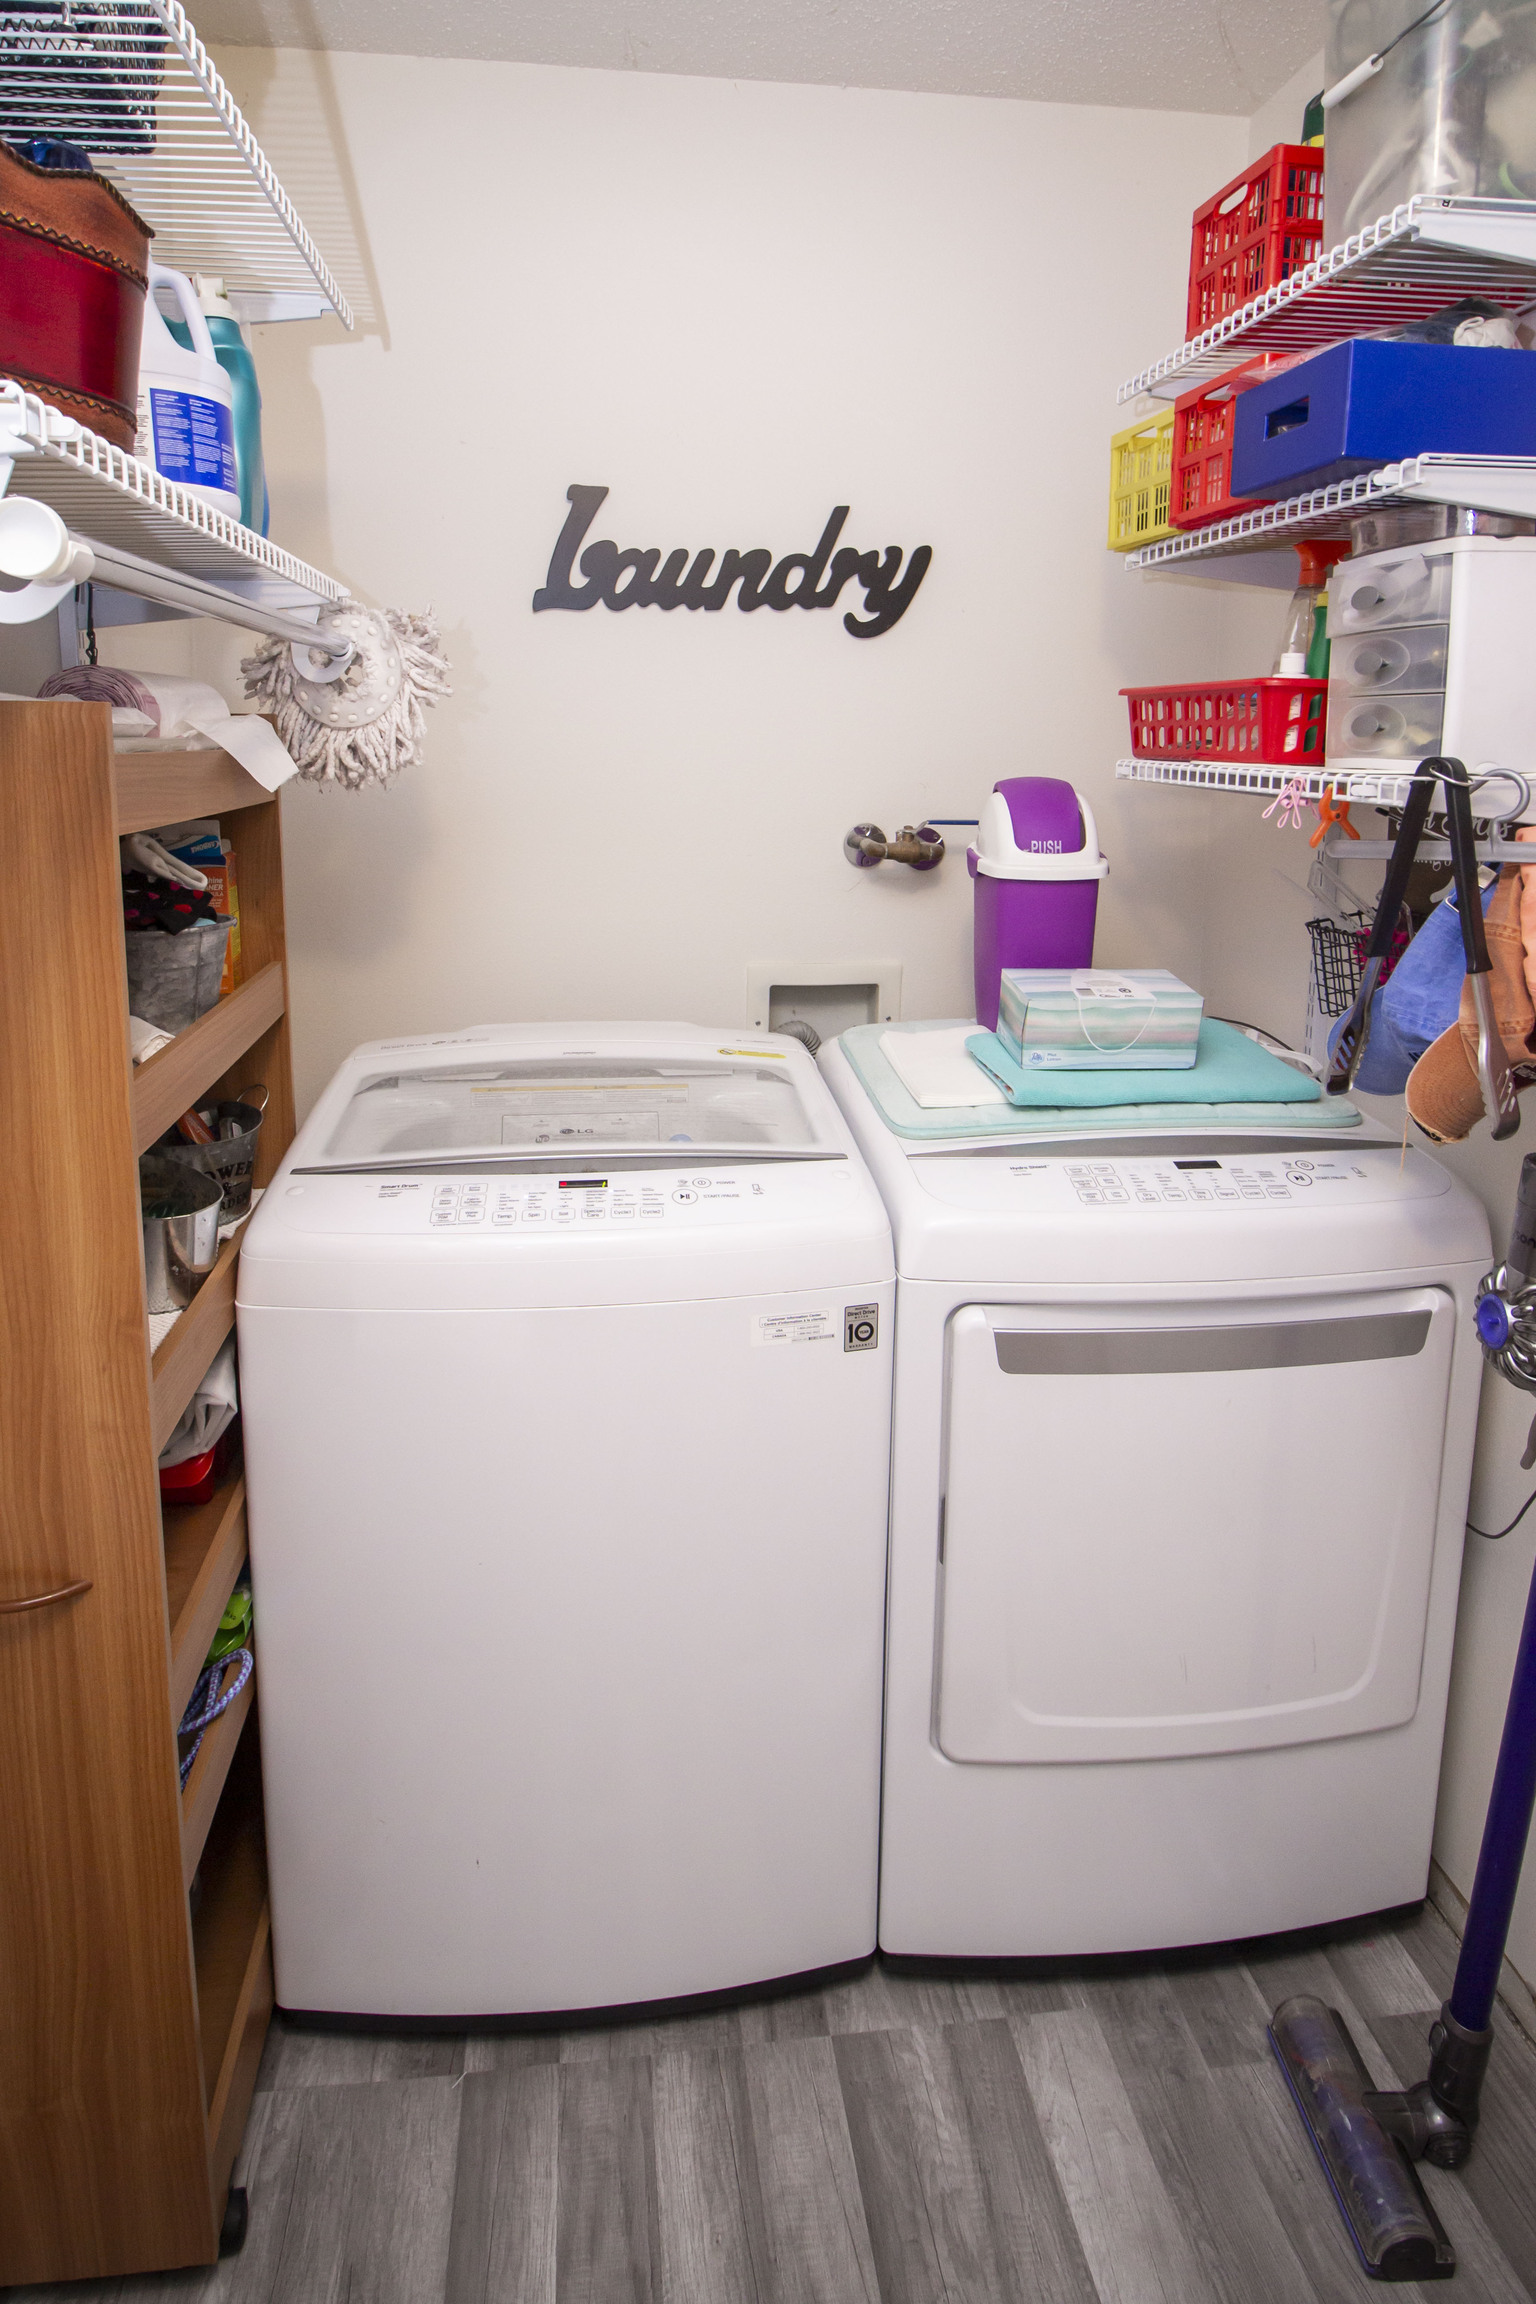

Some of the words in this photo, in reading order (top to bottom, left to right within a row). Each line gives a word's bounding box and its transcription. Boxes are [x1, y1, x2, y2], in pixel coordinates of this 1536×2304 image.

[532, 484, 933, 639] Laundry
[1031, 840, 1062, 854] PUSH
[847, 1321, 874, 1343] 10
